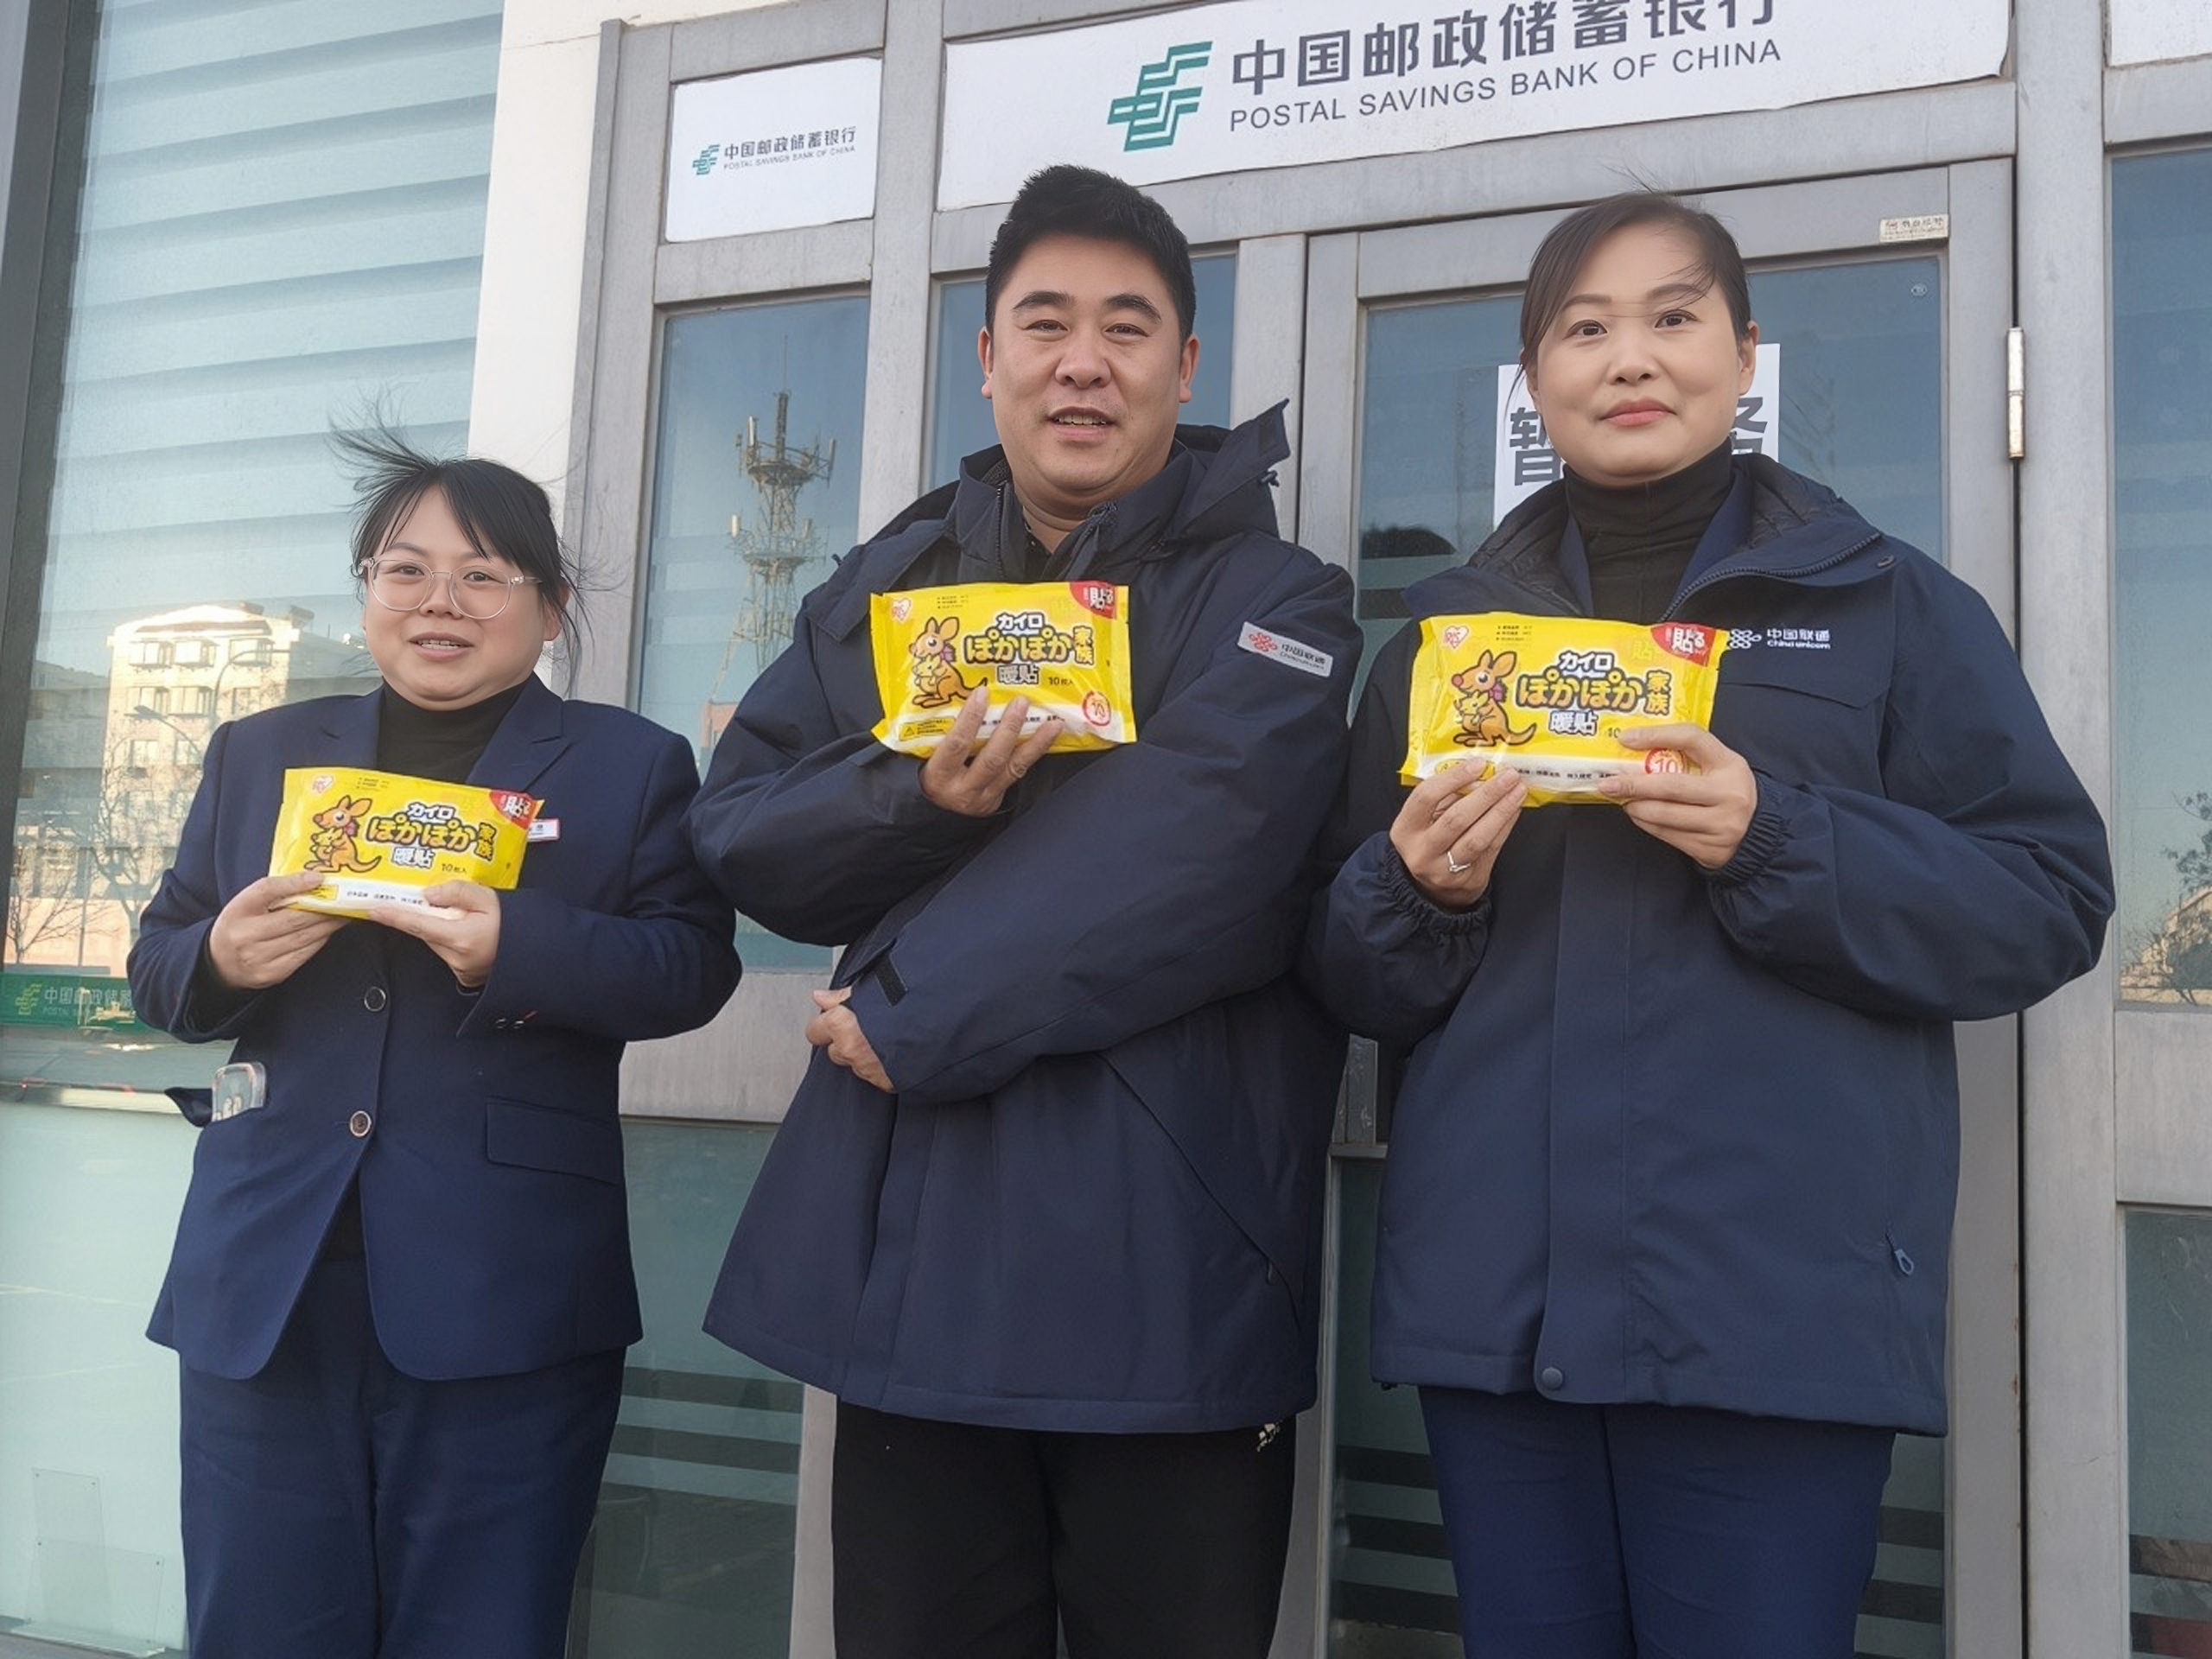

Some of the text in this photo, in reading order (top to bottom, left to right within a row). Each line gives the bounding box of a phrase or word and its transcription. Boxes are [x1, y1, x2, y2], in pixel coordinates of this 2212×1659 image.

[1231, 39, 1781, 131] POSTAL SAVINGS BANK OF CHINA
[724, 159, 753, 170] POSTAL
[756, 155, 790, 167] SAVINGS
[792, 151, 814, 162] BANK
[830, 145, 855, 156] CHINA
[725, 126, 856, 159] 中国邮政储蓄银行
[996, 613, 1045, 630] カイロ
[1767, 628, 1829, 641] 中国联通
[965, 627, 1072, 663] ぽかぽか
[1560, 651, 1613, 671] カイロ
[1518, 667, 1643, 710] ぽかぽか
[1646, 671, 1670, 715] 家族
[407, 803, 455, 819] カイロ
[366, 813, 477, 852] ぽかぽか
